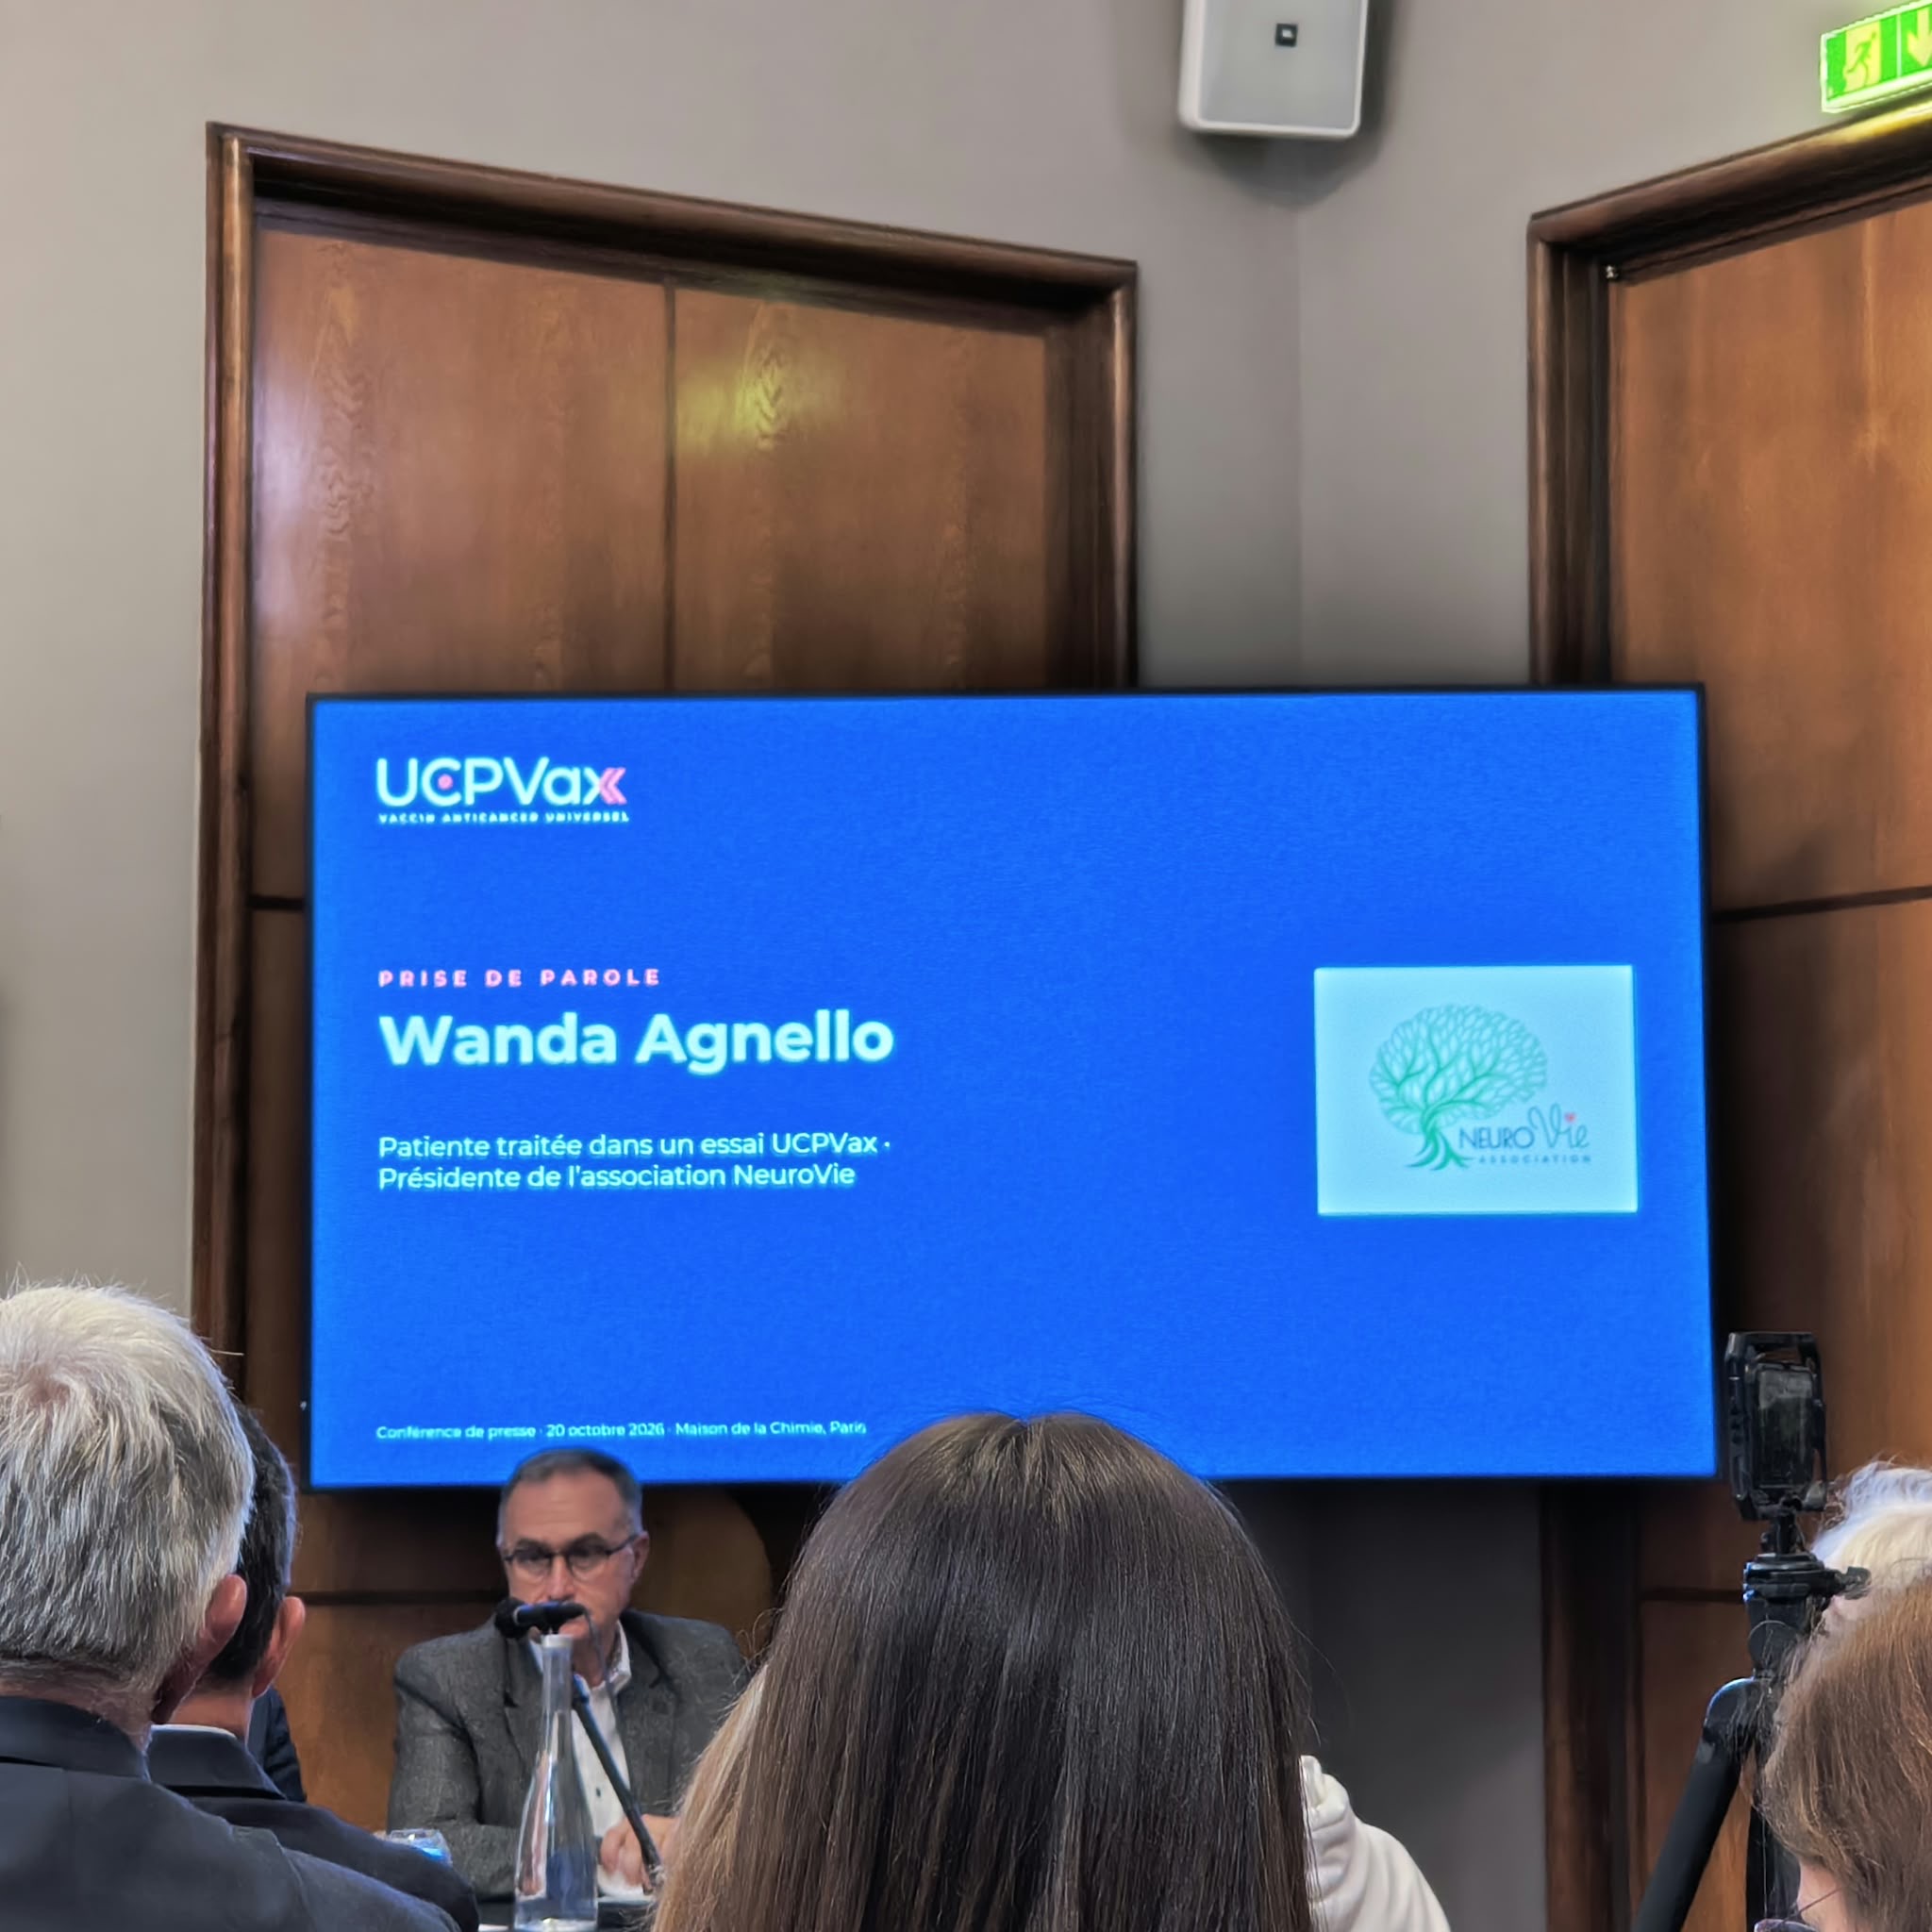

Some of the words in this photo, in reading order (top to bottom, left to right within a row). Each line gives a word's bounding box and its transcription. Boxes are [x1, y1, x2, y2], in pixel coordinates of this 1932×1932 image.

[377, 758, 626, 807] UCPVax
[378, 812, 436, 824] VACCIN
[545, 811, 629, 824] UNIVERSEL
[378, 970, 467, 988] PRISE
[485, 969, 522, 988] DE
[540, 968, 660, 987] PAROLE
[379, 1012, 616, 1065] Wanda
[635, 1009, 893, 1074] Agnello
[379, 1136, 490, 1158] Patiente
[497, 1134, 582, 1157] traitée
[590, 1134, 653, 1156] dans
[660, 1138, 693, 1156] un
[701, 1132, 764, 1155] essai
[773, 1132, 877, 1154] UCPVax
[1478, 1153, 1591, 1164] ASSOCIATION
[379, 1166, 521, 1190] Présidente
[527, 1166, 561, 1188] de
[569, 1163, 725, 1187] l'association
[734, 1161, 855, 1185] NeuroVie
[376, 1425, 461, 1439] Conférence
[465, 1425, 484, 1438] de
[489, 1426, 536, 1441] presse
[547, 1424, 565, 1437] 20
[569, 1424, 625, 1437] octobre
[629, 1423, 664, 1436] 2026
[675, 1422, 727, 1435] Maison
[731, 1422, 750, 1435] de
[755, 1422, 766, 1434] la
[770, 1421, 826, 1435] Chimie,
[830, 1420, 867, 1434] Paris
